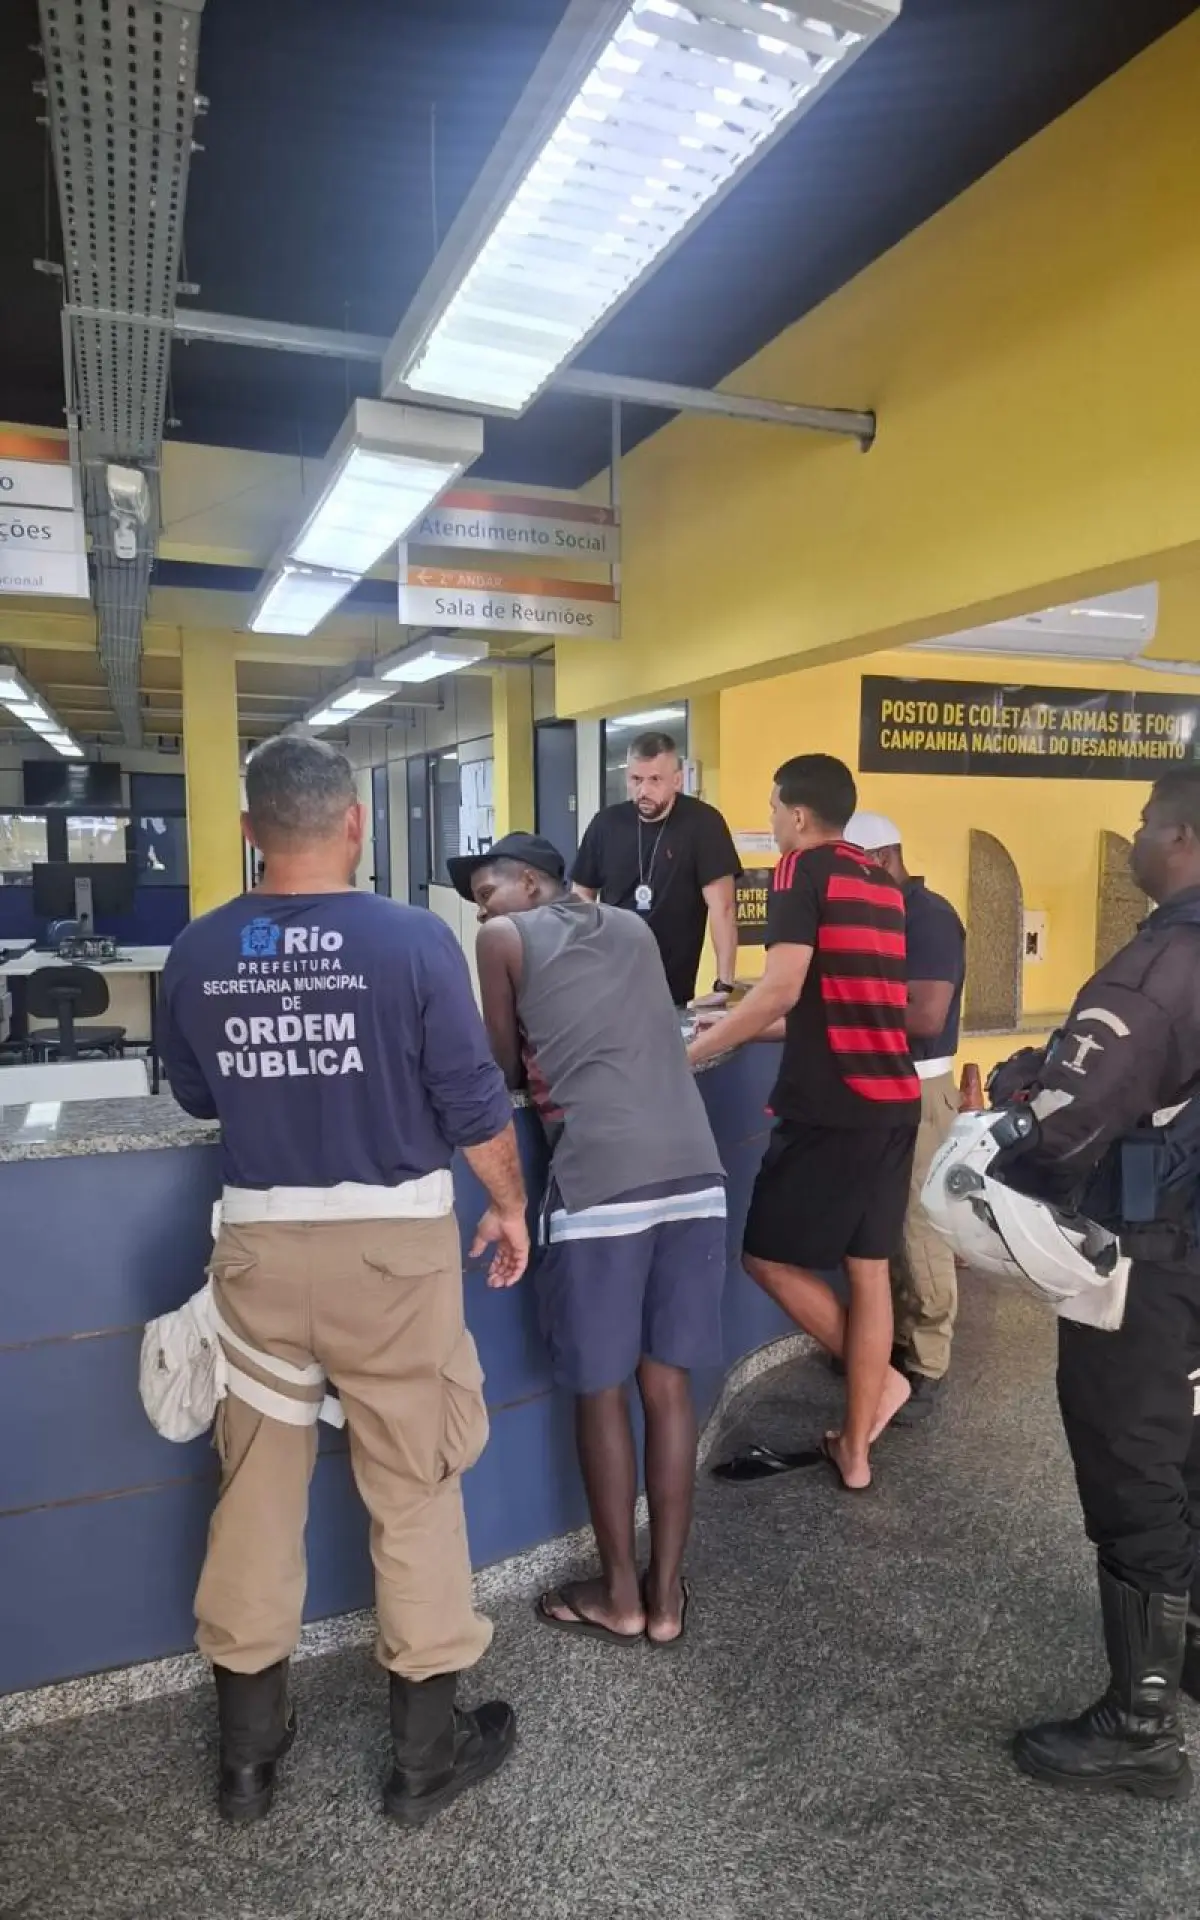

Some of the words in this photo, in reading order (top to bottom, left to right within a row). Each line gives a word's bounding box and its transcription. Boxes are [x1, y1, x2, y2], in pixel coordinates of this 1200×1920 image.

[419, 518, 549, 544] Atendimento
[554, 530, 606, 552] Social
[0, 575, 43, 586] cional
[434, 598, 475, 617] Sala
[482, 600, 505, 619] de
[511, 603, 594, 627] Reuniões
[881, 699, 937, 724] POSTO
[943, 703, 964, 727] DE
[969, 704, 1031, 730] COLETA
[1037, 707, 1057, 730] DE
[1060, 709, 1117, 733] ARMAS
[1122, 712, 1142, 734] DE
[881, 728, 967, 752] CAMPANHA
[972, 733, 1045, 755] NACIONAL
[1049, 737, 1066, 756] DO
[1071, 737, 1185, 760] DESARMAMENTO
[737, 902, 767, 919] ARM
[284, 926, 343, 955] Rio
[238, 958, 342, 974] PREFEITURA
[203, 978, 291, 995] SECRETARIA
[294, 975, 367, 991] MUNICIPAL
[281, 996, 302, 1011] DE
[224, 1013, 356, 1045] ORDEM
[216, 1046, 364, 1078] PÚBLICA
